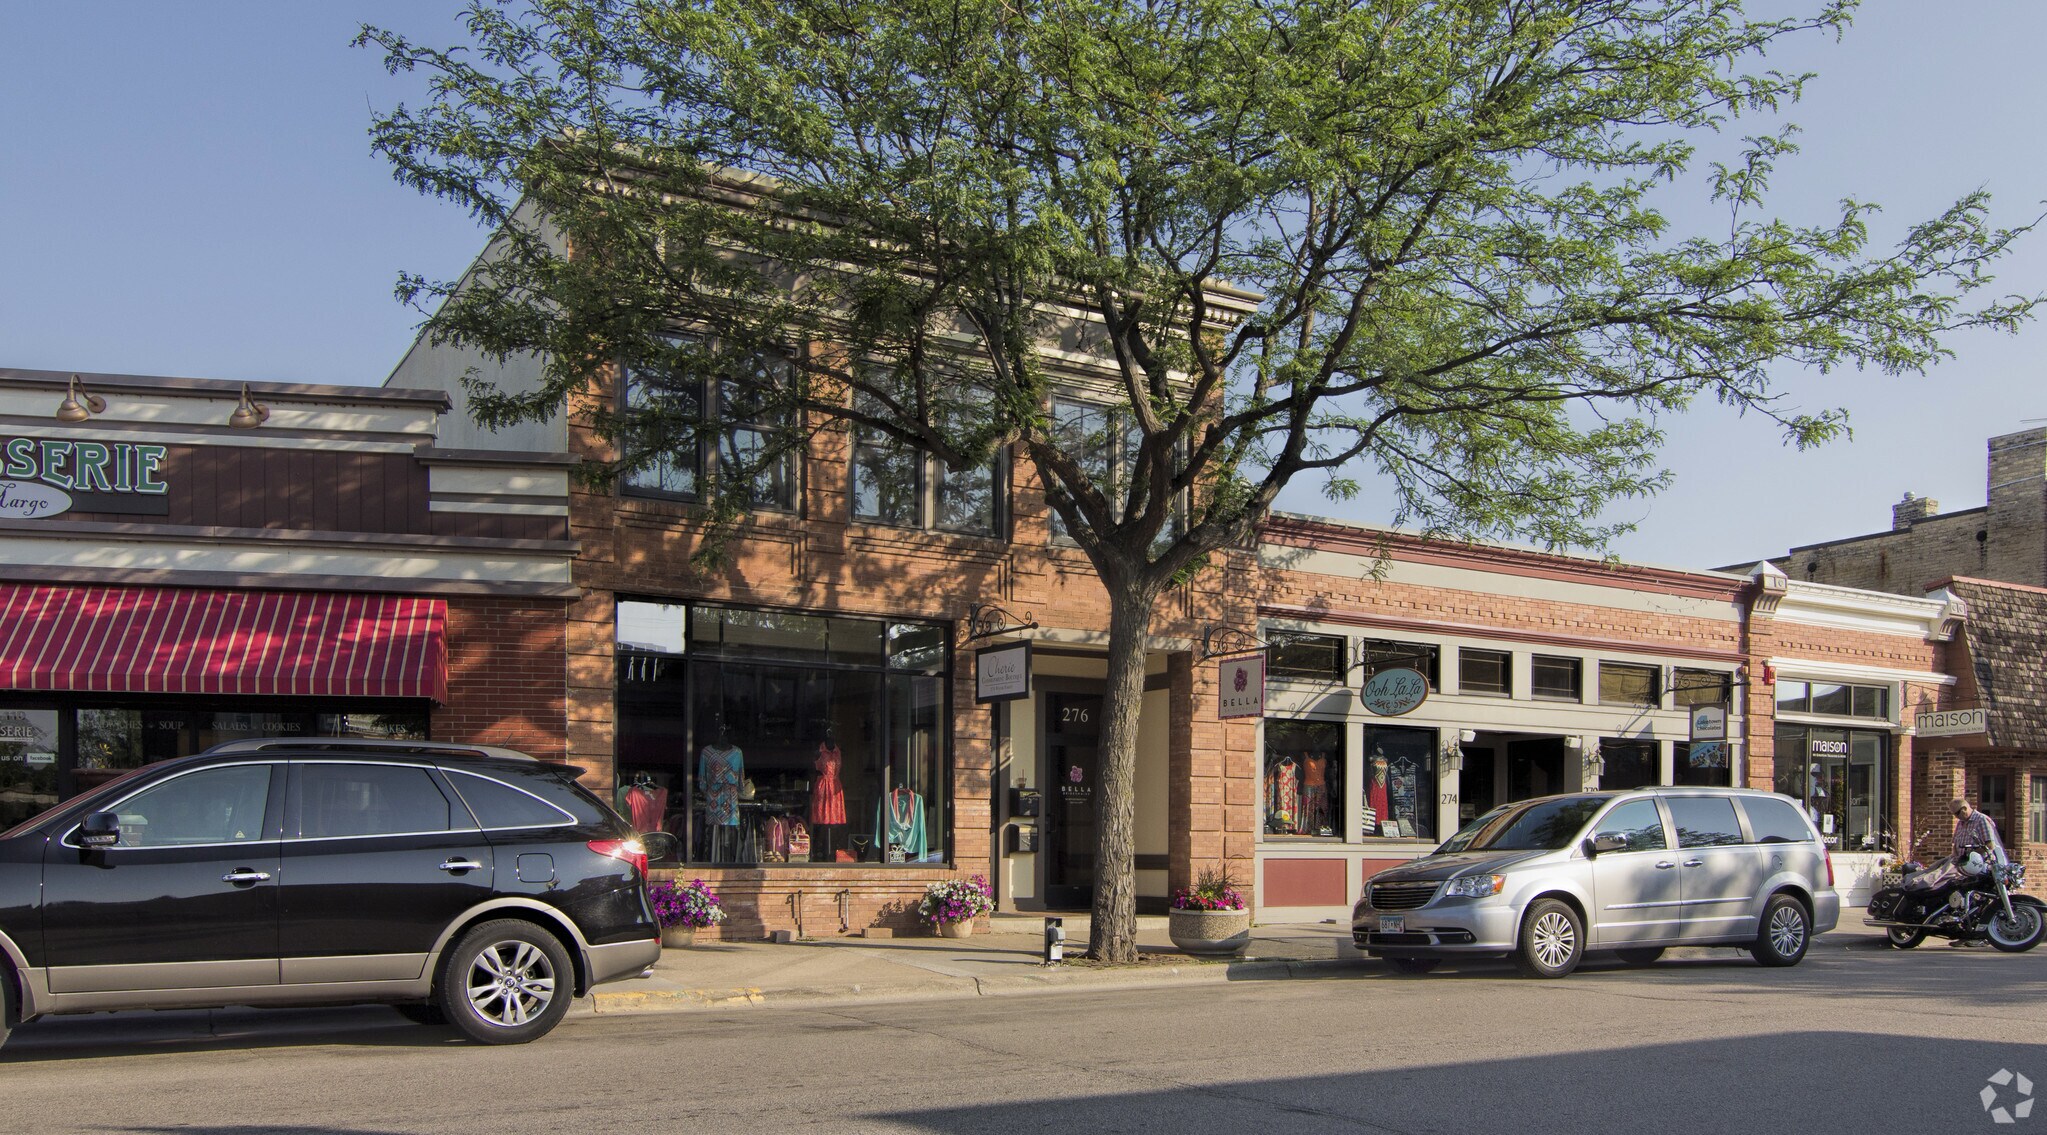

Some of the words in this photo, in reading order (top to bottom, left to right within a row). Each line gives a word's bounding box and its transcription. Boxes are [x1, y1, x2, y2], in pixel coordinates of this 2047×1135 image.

[0, 438, 170, 496] SERIE
[1365, 678, 1390, 697] Ooh
[1389, 676, 1408, 698] La
[1405, 678, 1423, 697] La
[1223, 697, 1259, 708] BELLA
[1062, 707, 1089, 722] 276
[1917, 710, 1984, 729] maison
[159, 720, 184, 730] SOUP
[212, 721, 248, 731] SALADS
[262, 722, 301, 732] COOKIES
[1812, 740, 1847, 754] maison
[1061, 785, 1092, 793] BELLA
[1441, 793, 1457, 804] 274
